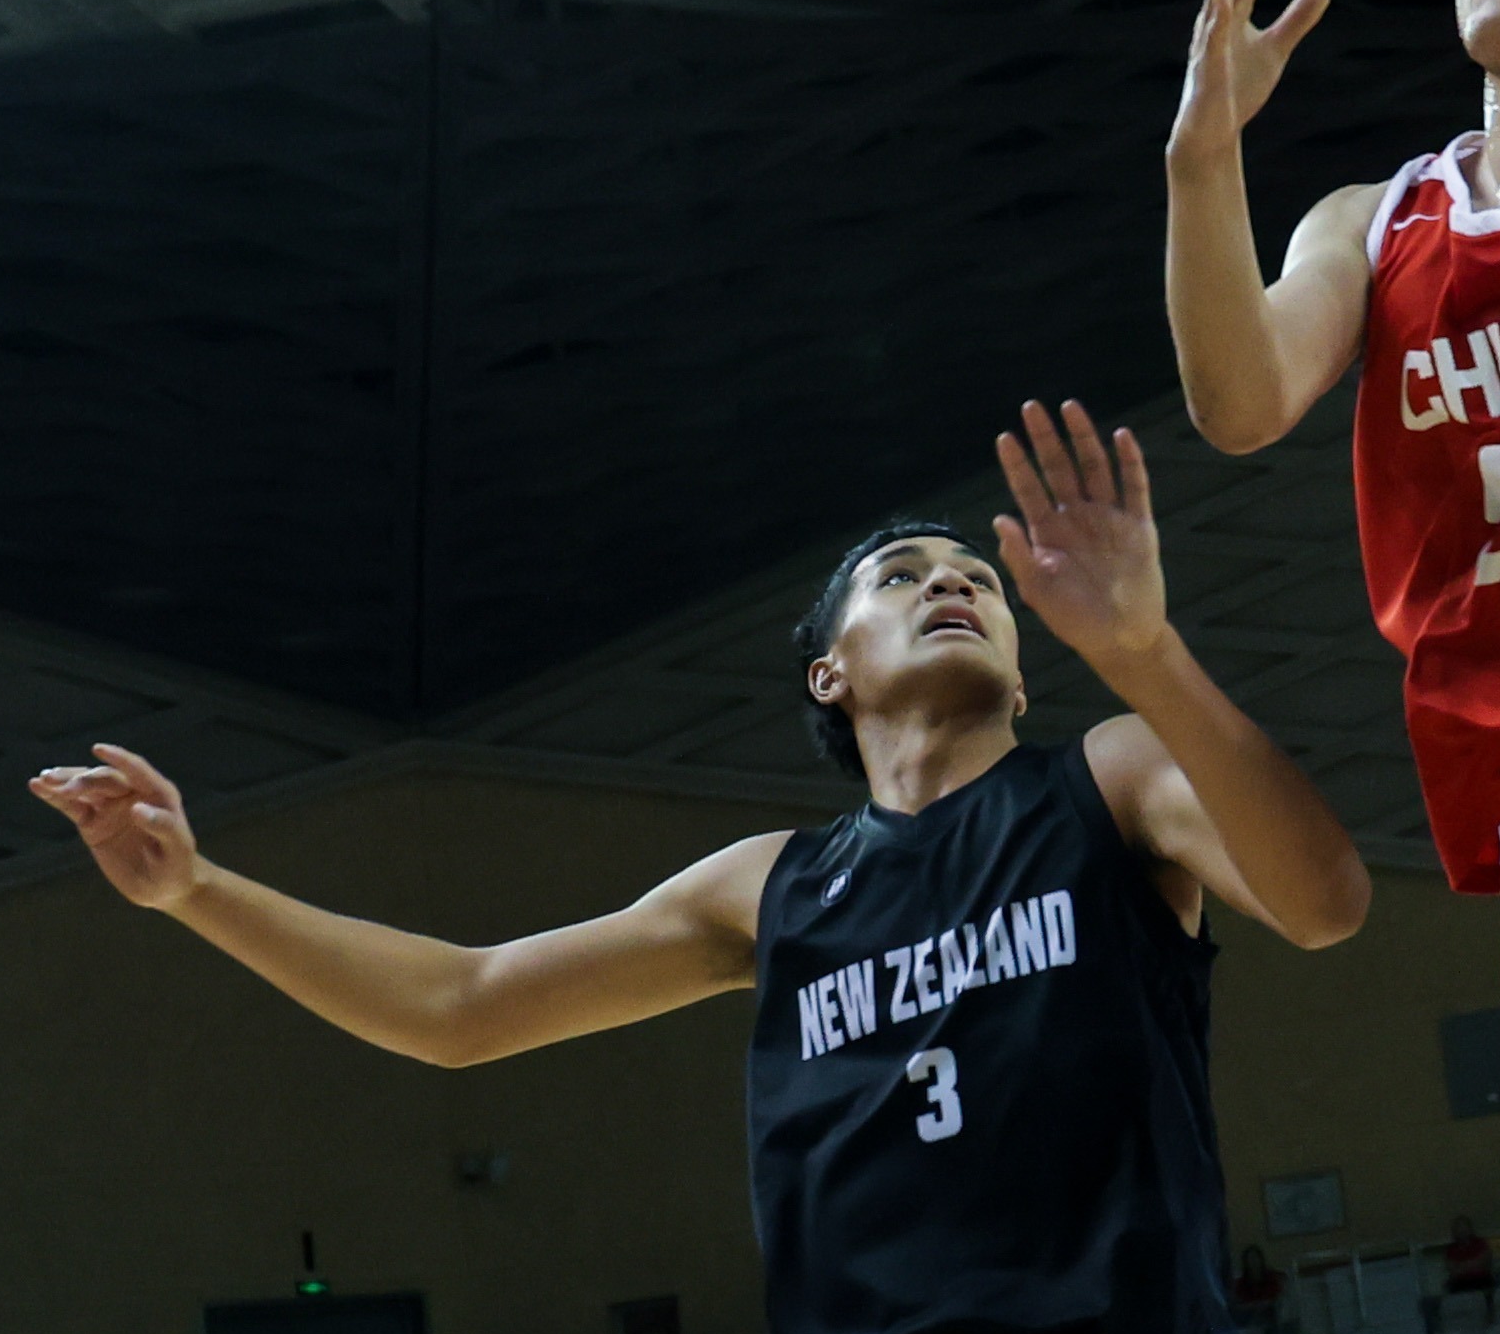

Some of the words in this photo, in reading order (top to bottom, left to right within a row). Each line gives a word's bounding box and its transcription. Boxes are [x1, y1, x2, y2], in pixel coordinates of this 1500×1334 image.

[797, 958, 877, 1062] NEW
[885, 889, 1077, 1024] ZEALAND
[906, 1046, 963, 1143] 3
